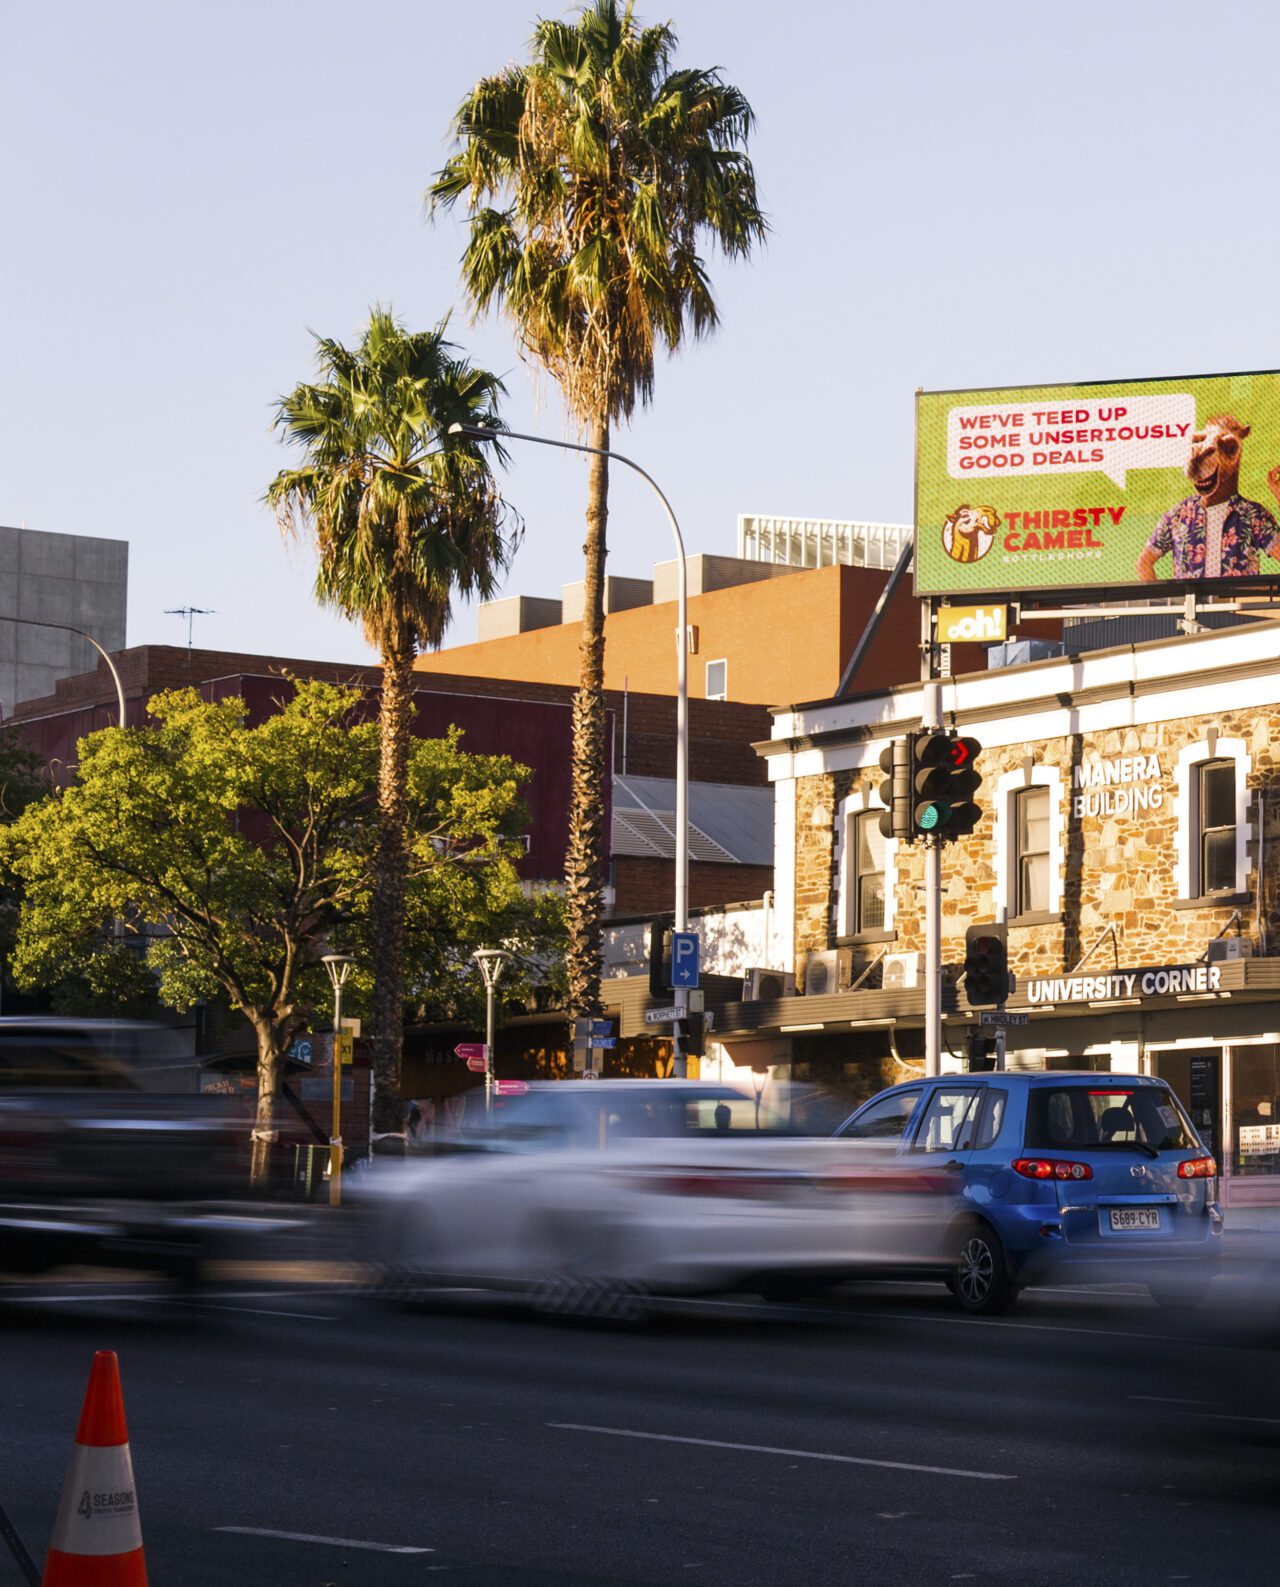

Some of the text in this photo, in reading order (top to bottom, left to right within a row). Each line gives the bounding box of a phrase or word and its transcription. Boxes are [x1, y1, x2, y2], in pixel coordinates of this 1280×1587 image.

[959, 407, 1127, 430] WE'VE TEED UP
[959, 423, 1191, 450] SOME UNSERIOUSLY
[959, 449, 1104, 470] GOOD DEALS
[1003, 506, 1127, 531] THIRSTY
[1003, 530, 1103, 552] CAMEL
[1075, 754, 1161, 788] MANERA
[1074, 784, 1163, 819] BUILDING
[676, 939, 694, 963] P
[1027, 966, 1221, 1003] UNIVERSITY CORNER
[991, 1015, 1026, 1024] HINDLEY ST
[78, 1490, 133, 1519] 4 SEASONS
